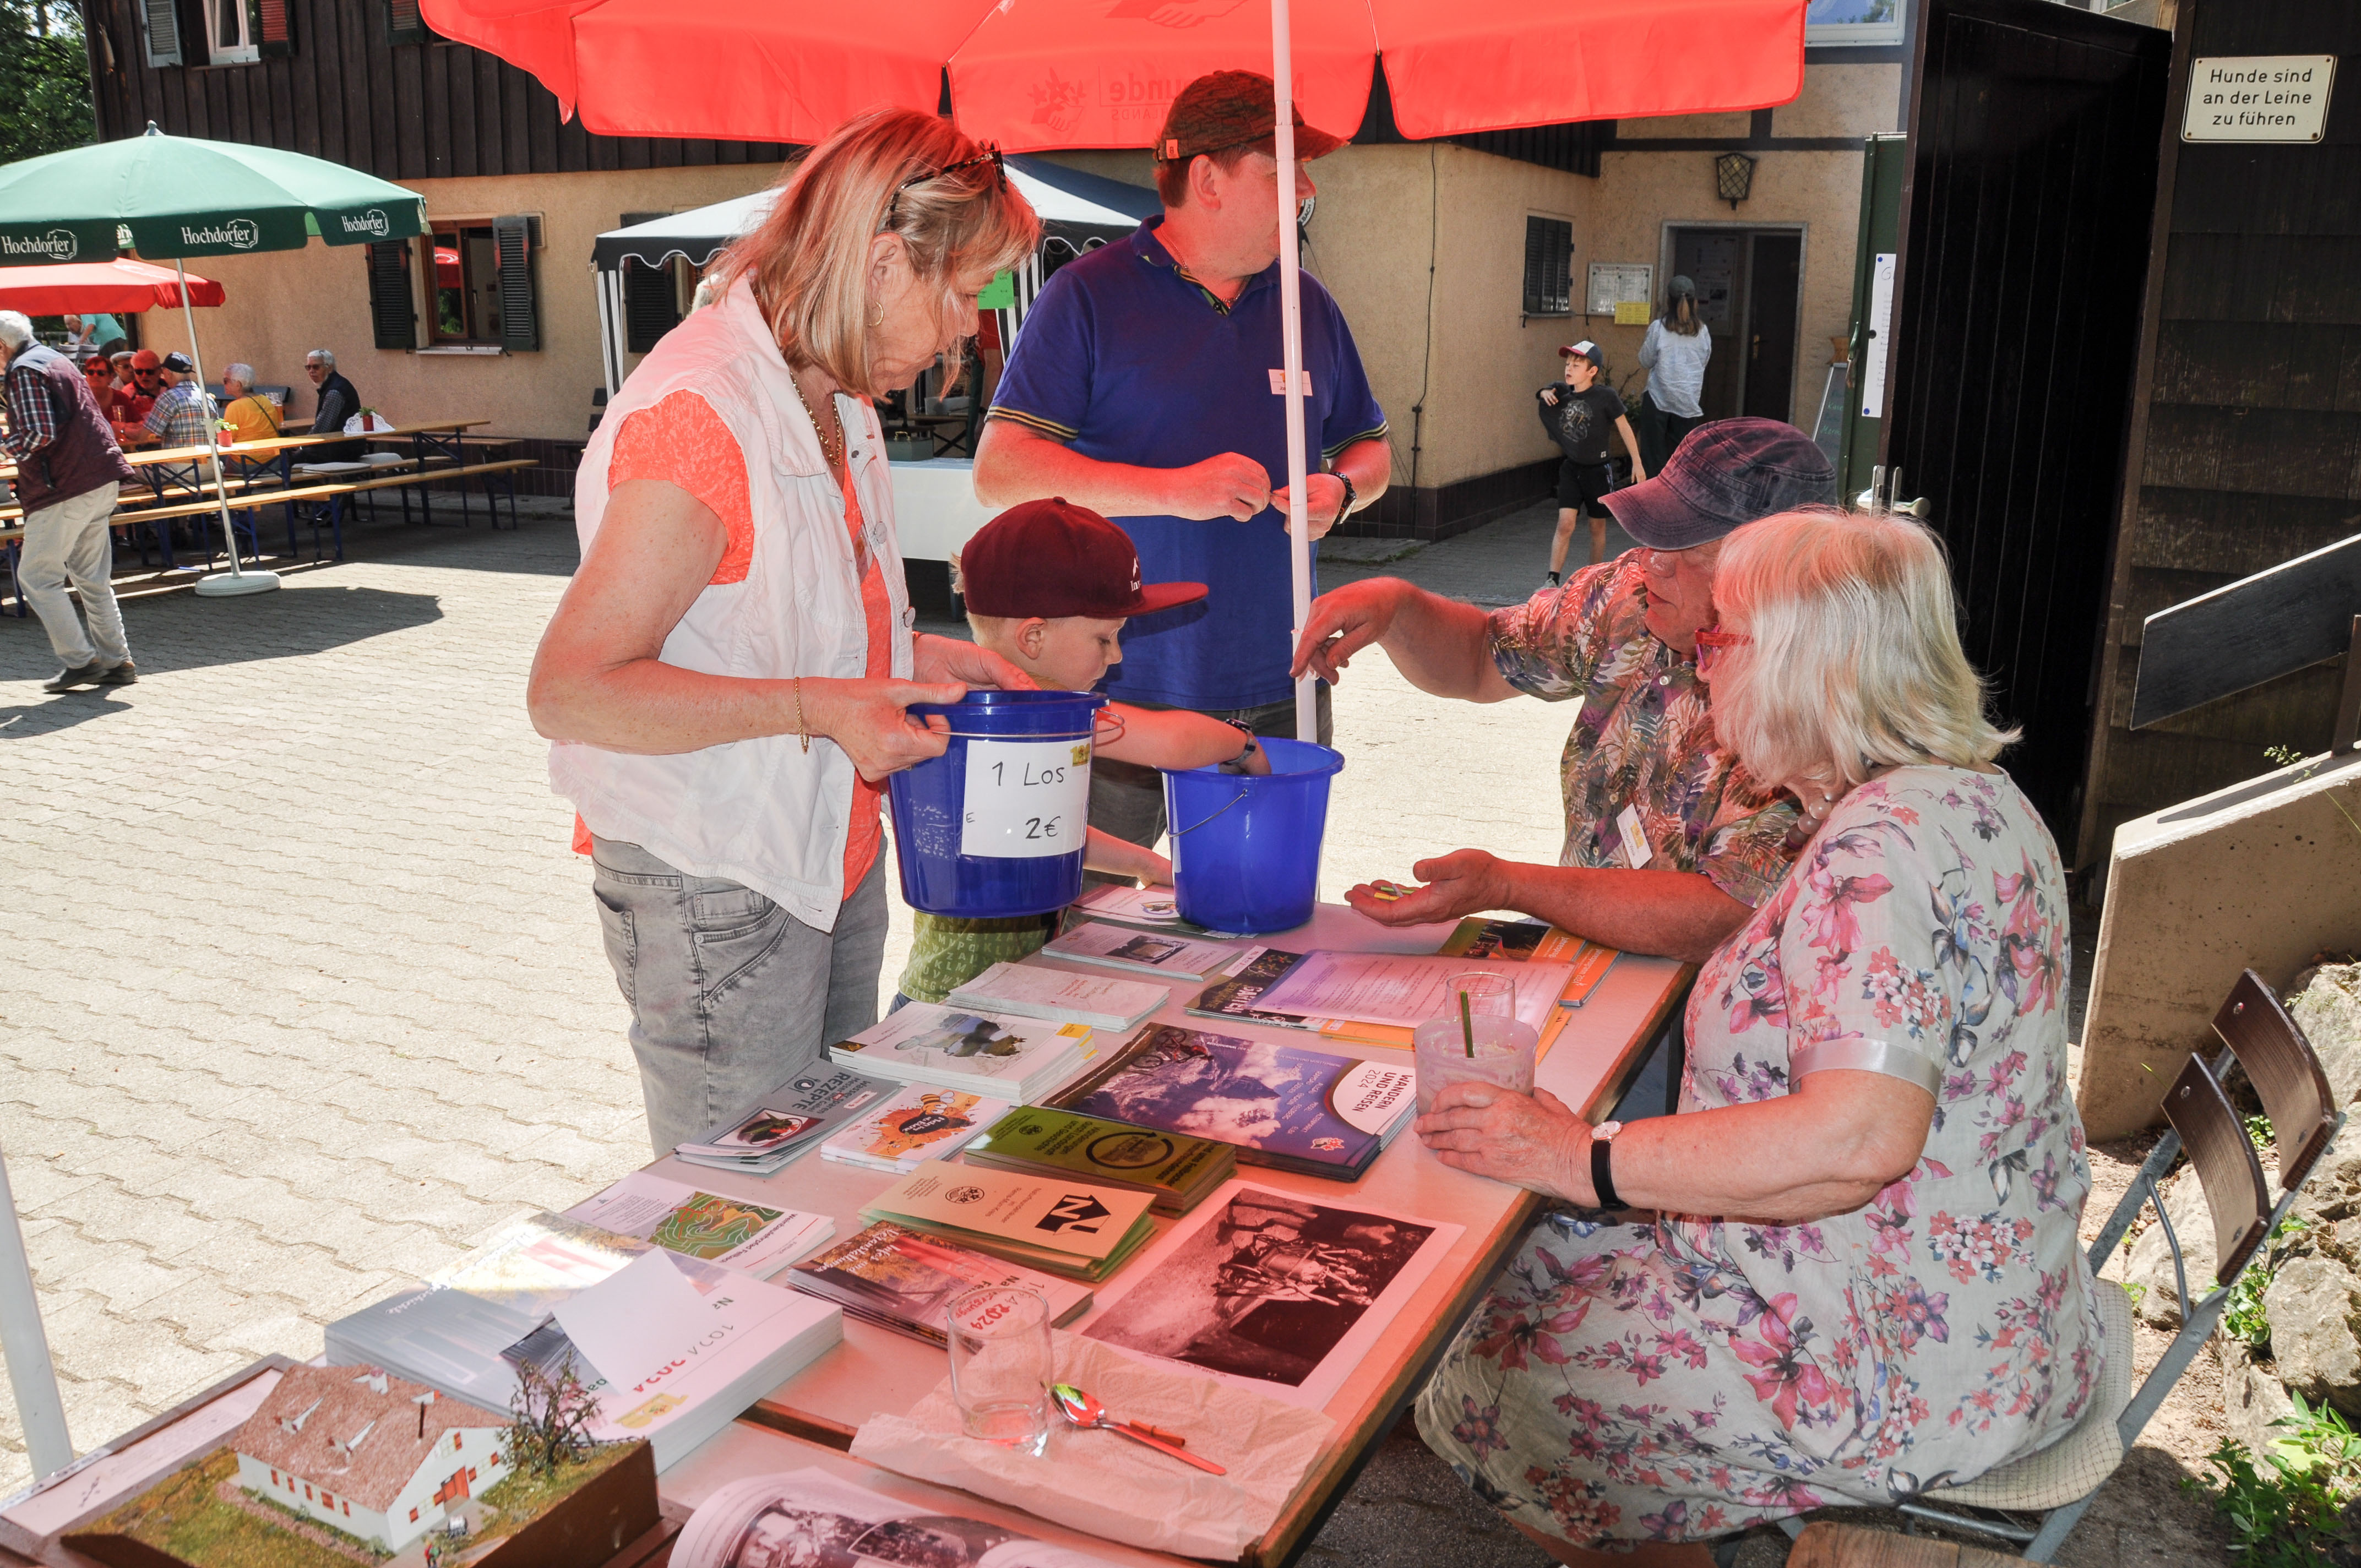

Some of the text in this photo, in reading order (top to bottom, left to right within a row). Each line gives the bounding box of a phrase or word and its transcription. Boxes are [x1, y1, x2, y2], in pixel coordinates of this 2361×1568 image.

[2210, 68, 2313, 83] Hunde sind
[2203, 90, 2312, 104] an der Leine
[2212, 111, 2295, 126] zu führen
[341, 214, 384, 232] Hochdorfer
[1, 235, 69, 254] Hochdorfer
[181, 225, 250, 244] Hochdorfer
[992, 761, 1065, 786] 1 Los
[1025, 816, 1061, 839] 2€
[841, 1080, 872, 1098] Wasser
[1357, 1069, 1381, 1088] 2024
[791, 1072, 852, 1112] REZEPTE
[1352, 1071, 1397, 1112] UND REISEN
[1374, 1074, 1413, 1109] WANDERN
[817, 1097, 845, 1115] sparen
[717, 1213, 797, 1263] Weinbaulehrpfad Fellbach
[808, 1228, 904, 1276] Veranstaltungen
[844, 1243, 903, 1275] Infos und
[384, 1281, 453, 1315] Geschichte
